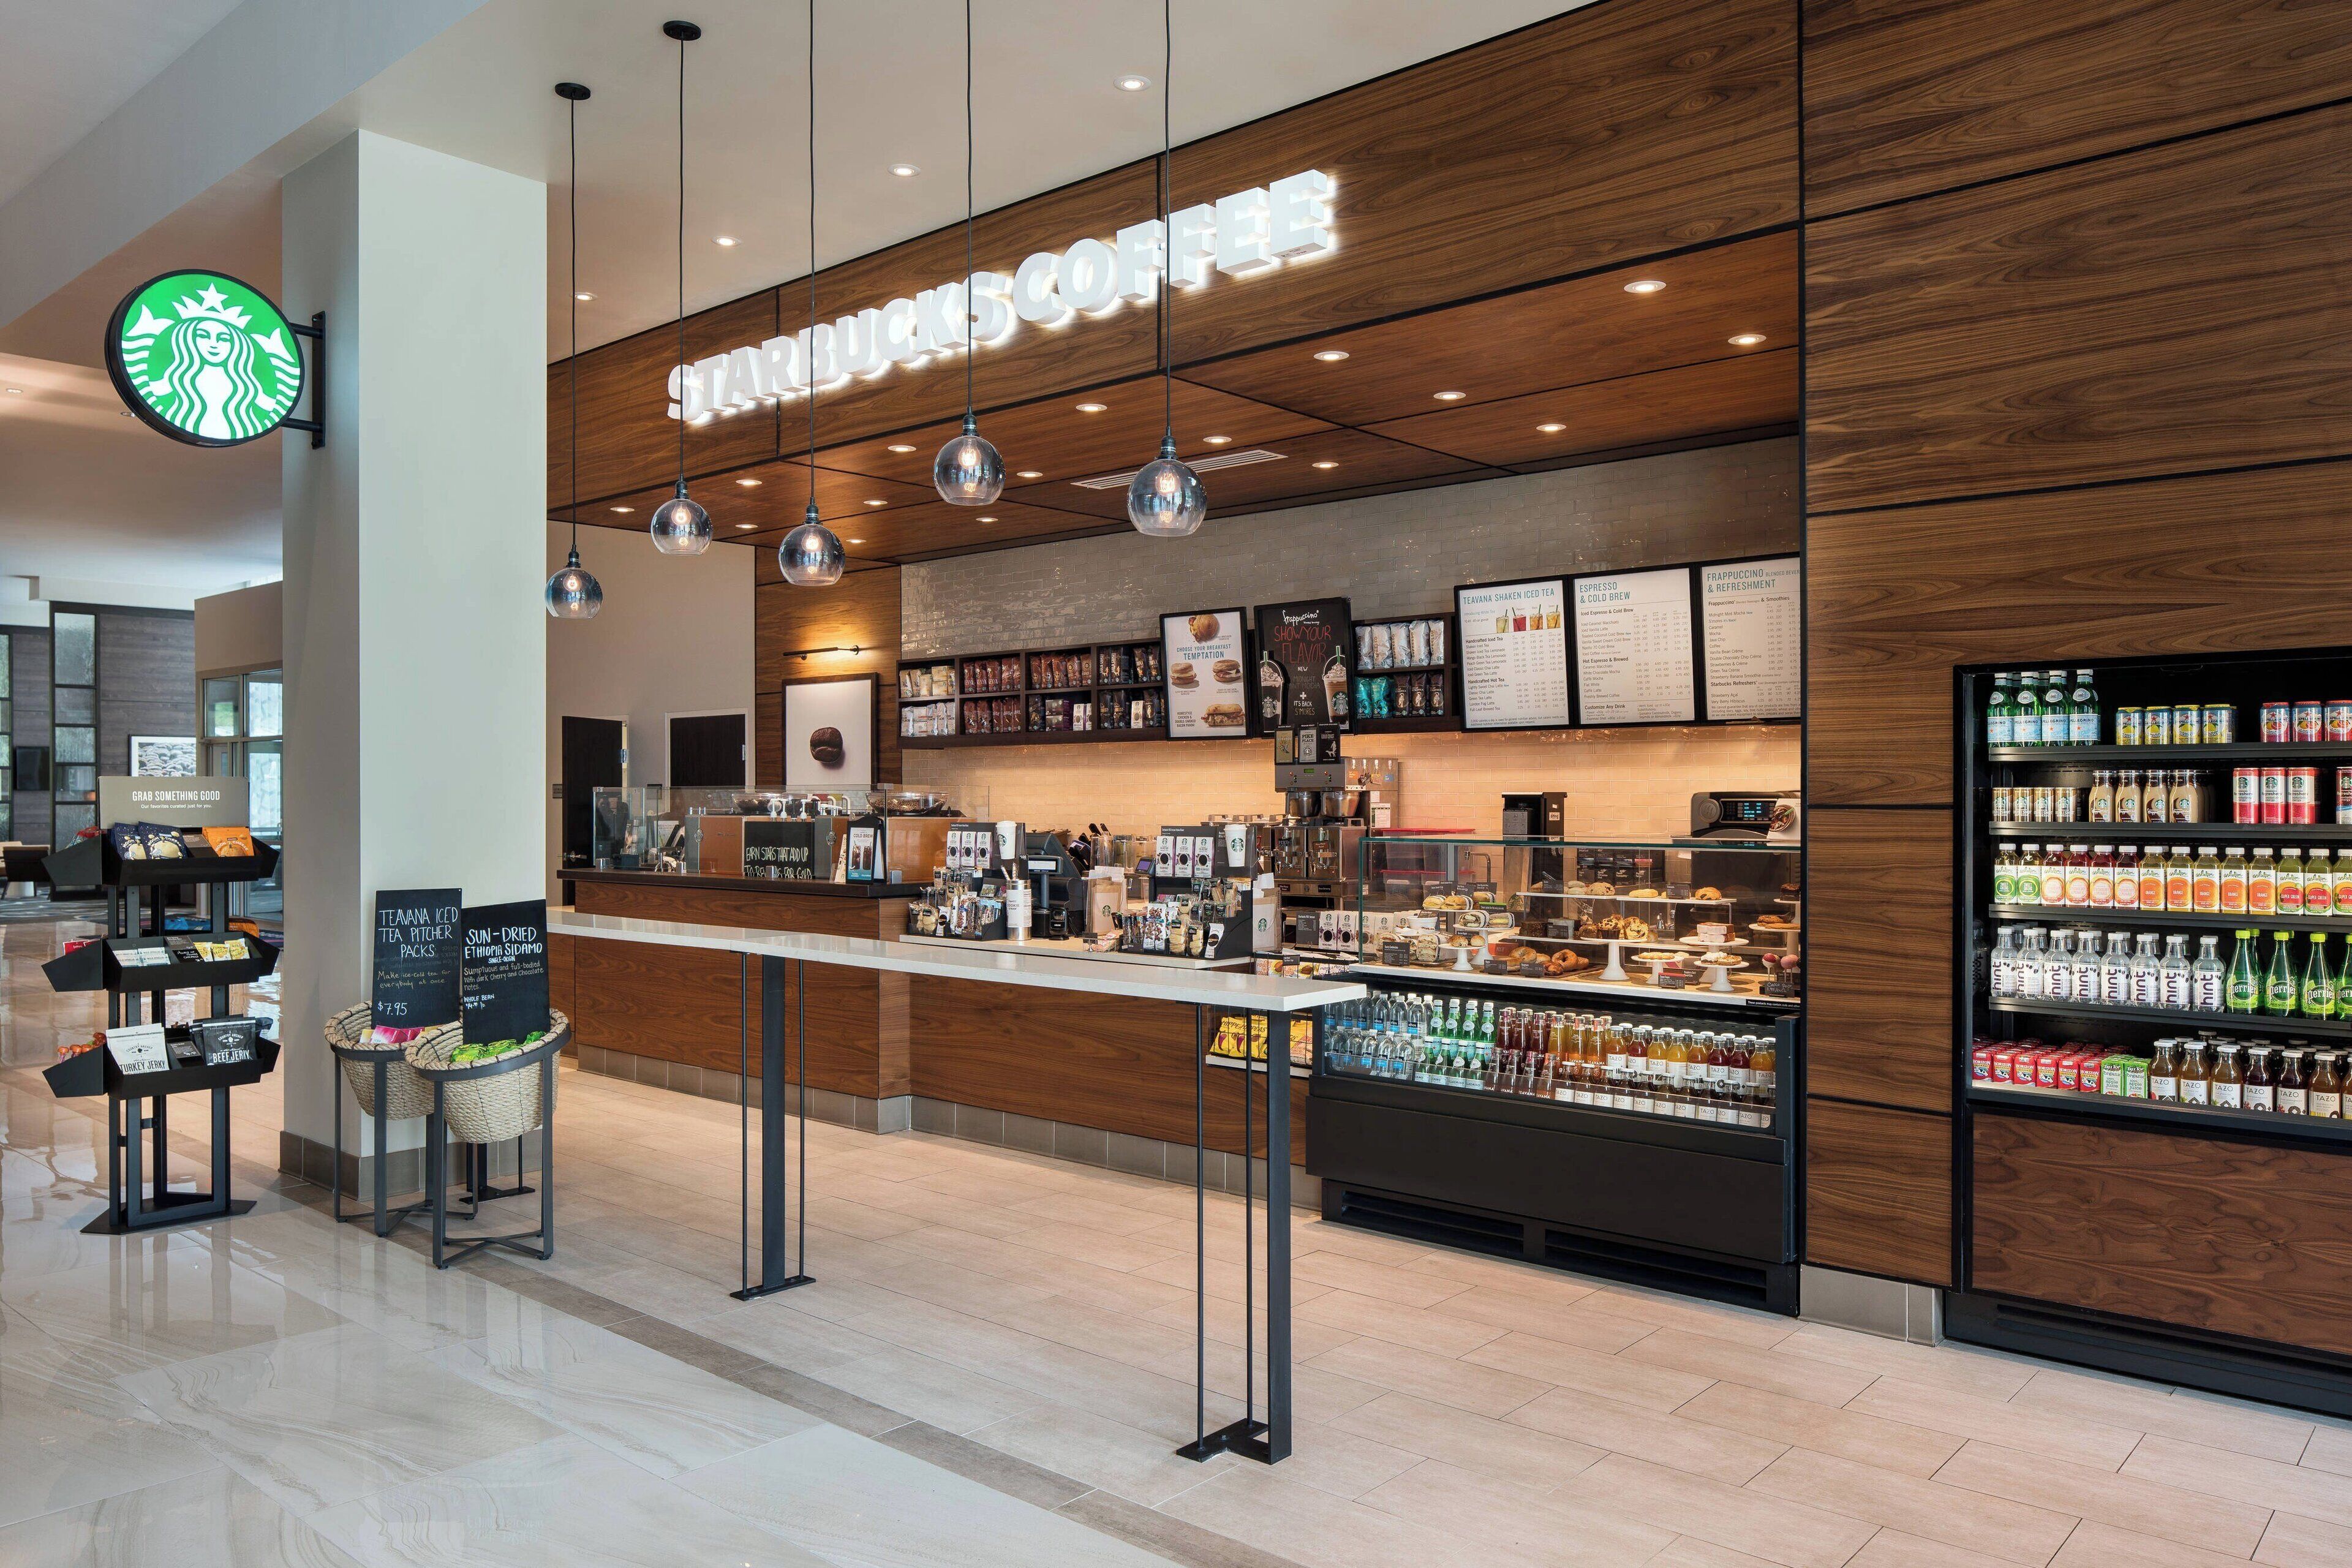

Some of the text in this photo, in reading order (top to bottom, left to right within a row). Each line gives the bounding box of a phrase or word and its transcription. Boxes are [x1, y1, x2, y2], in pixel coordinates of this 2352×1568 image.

[668, 169, 1327, 423] STARBUCKS COFFEE
[1708, 569, 1763, 581] FRAPPUCCINO
[1580, 582, 1617, 592] ESPRESSO
[1708, 579, 1776, 593] & REFRESHMENT
[1463, 588, 1555, 605] TEAVANA SHAKEN ICED TEA
[1588, 594, 1606, 603] COLD
[1610, 592, 1630, 601] BREW
[1274, 625, 1331, 641] SHOW YOUR
[1183, 650, 1224, 660] TEMPTATION
[1282, 643, 1327, 664] FLAVOR
[132, 791, 220, 801] GRAB SOMETHING GOOD
[746, 846, 809, 862] EARN STARS THAT ADD UP
[379, 907, 458, 925] TEAVANA ICED
[379, 925, 453, 942] TEA PITCHER
[401, 944, 435, 958] PACKS
[465, 943, 542, 959] ETHIOPIA SIDAMO
[377, 971, 400, 980] Make
[464, 966, 497, 976] Sumptuous
[511, 960, 540, 970] full-bodied
[1992, 962, 2001, 990] hint
[2049, 965, 2060, 995] hint
[380, 980, 413, 989] everybody
[2200, 974, 2213, 1006] hint
[378, 1001, 407, 1016] $7.95
[213, 1050, 251, 1063] BEEF JERKY
[119, 1060, 165, 1072] TURKEY JERKY
